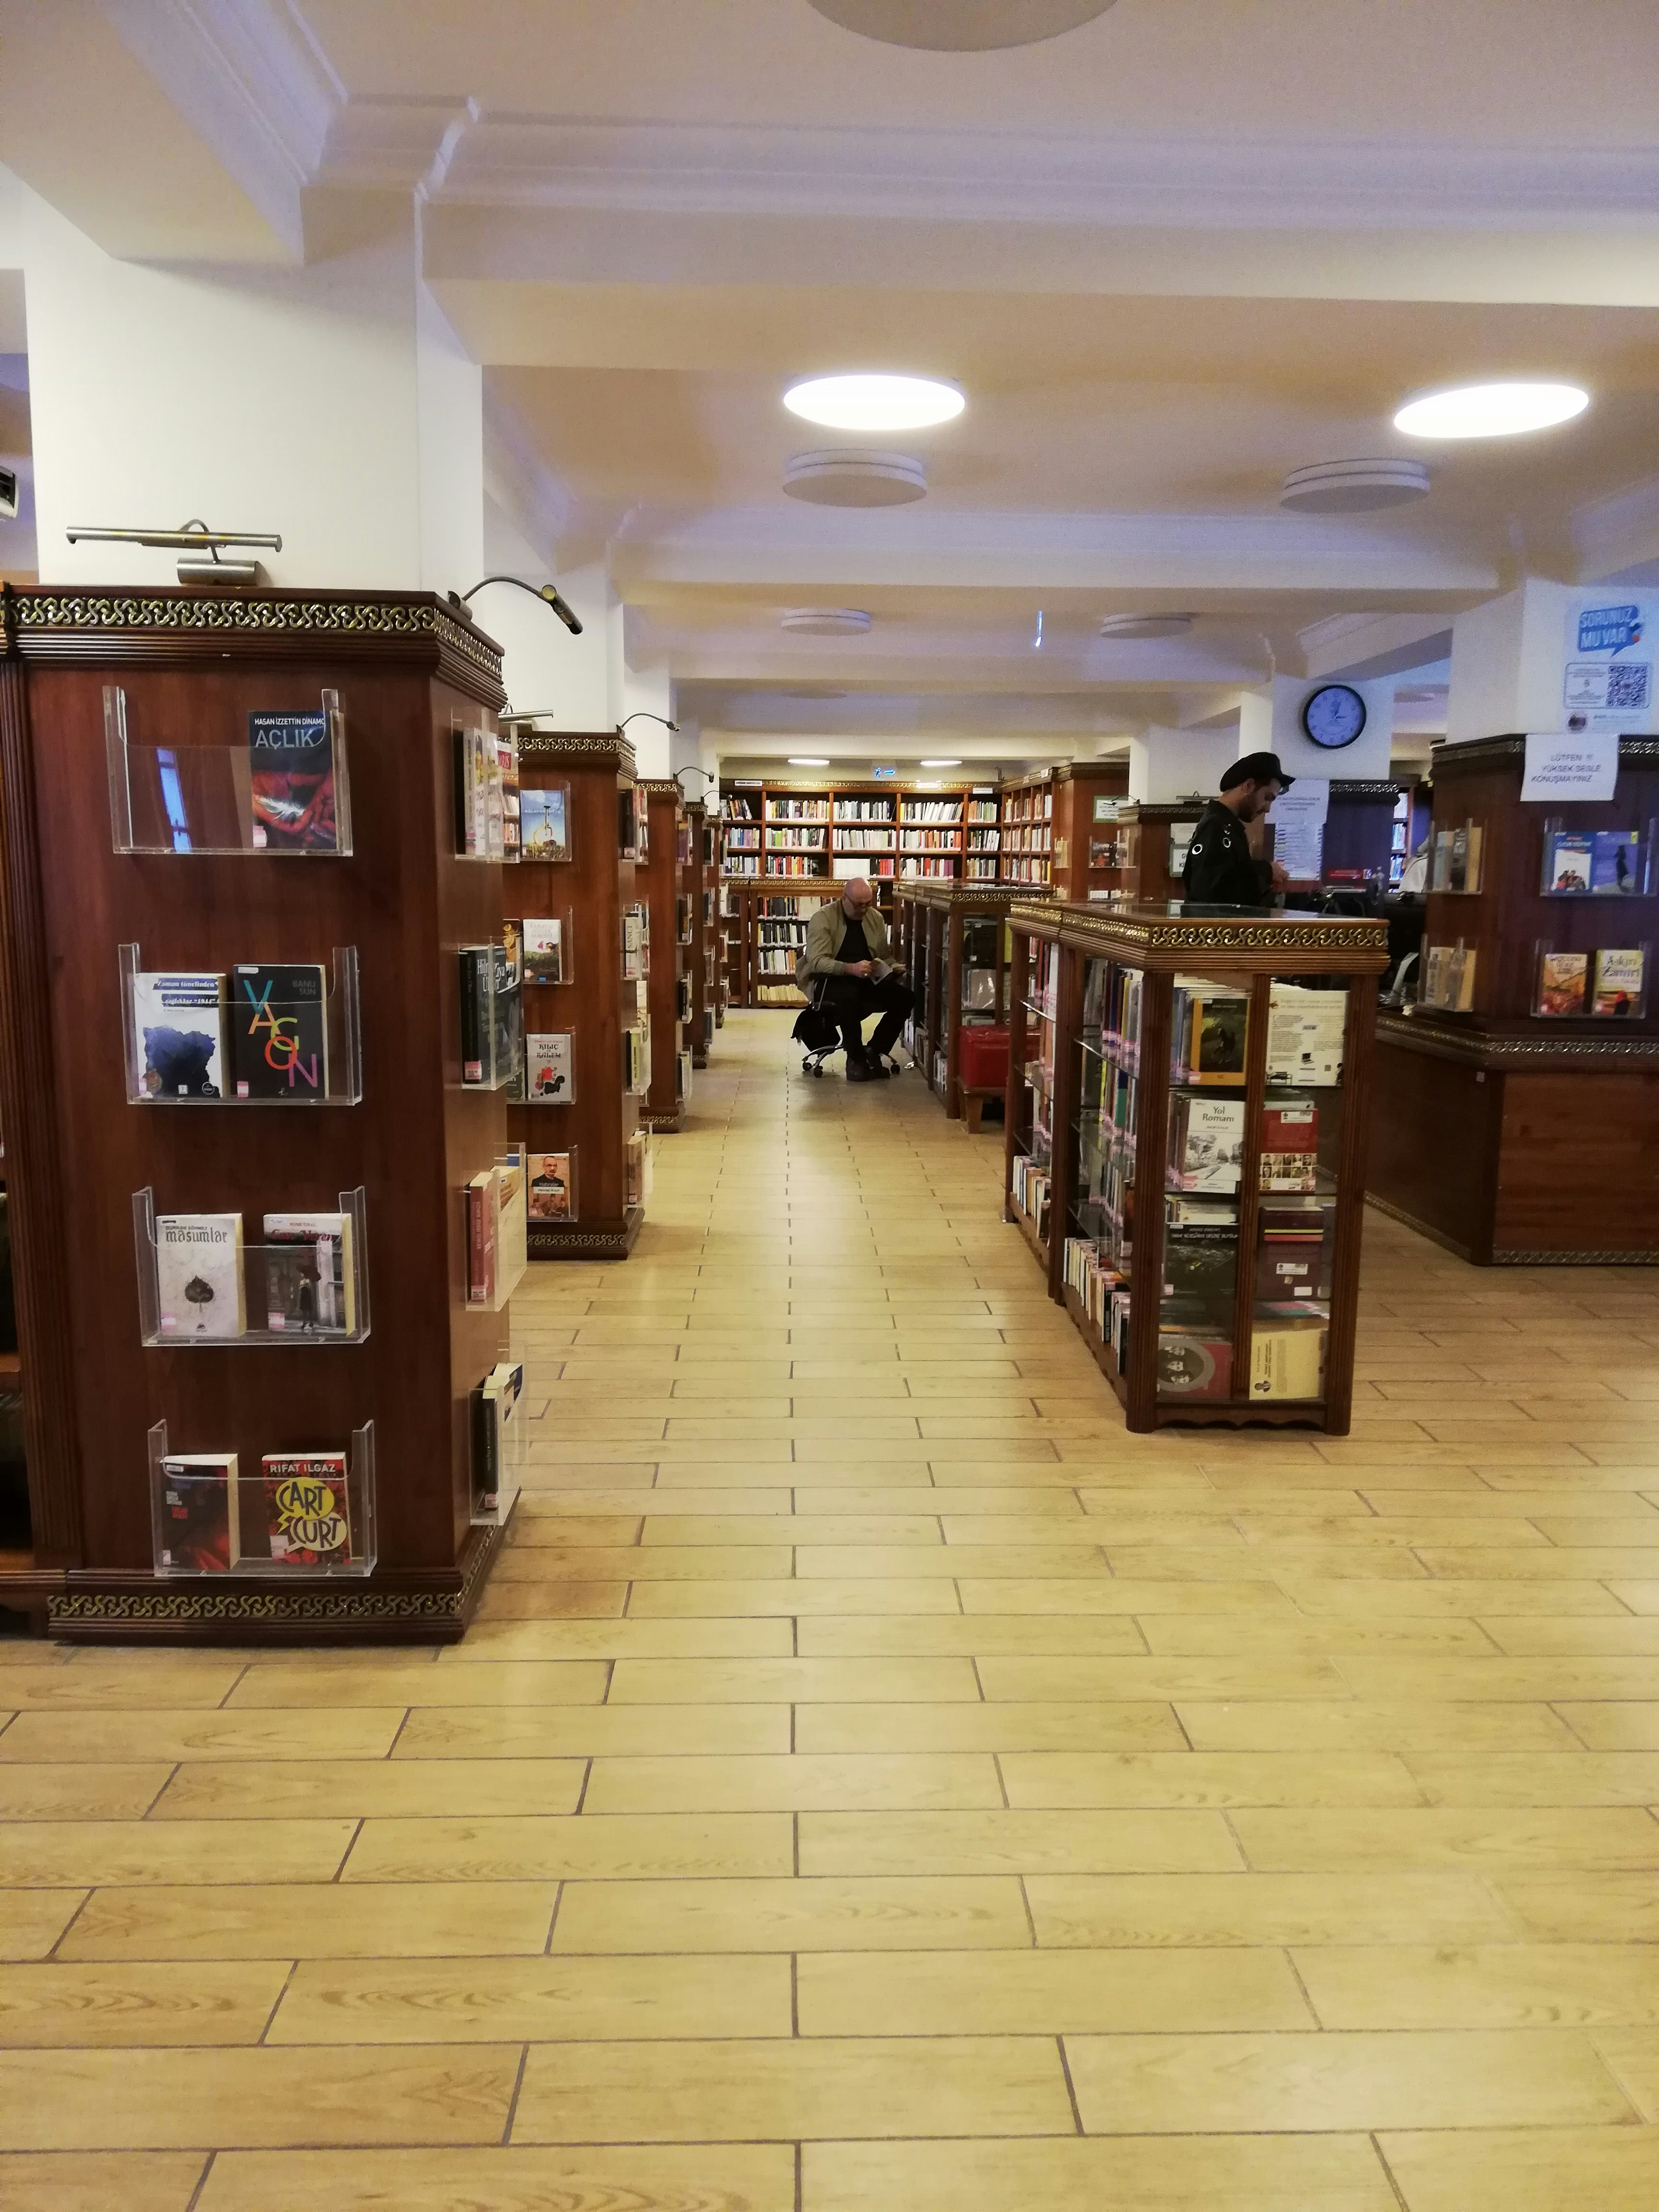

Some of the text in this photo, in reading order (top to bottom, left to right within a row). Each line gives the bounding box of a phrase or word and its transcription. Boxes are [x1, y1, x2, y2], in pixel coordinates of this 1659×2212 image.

[276, 717, 301, 725] İZZETTİN
[255, 729, 314, 750] AÇLIK
[1213, 1106, 1225, 1114] Yol
[166, 1227, 228, 1242] masumlar
[270, 1464, 300, 1473] RIFAT
[279, 1481, 326, 1516] CART
[293, 1515, 341, 1548] CURT
